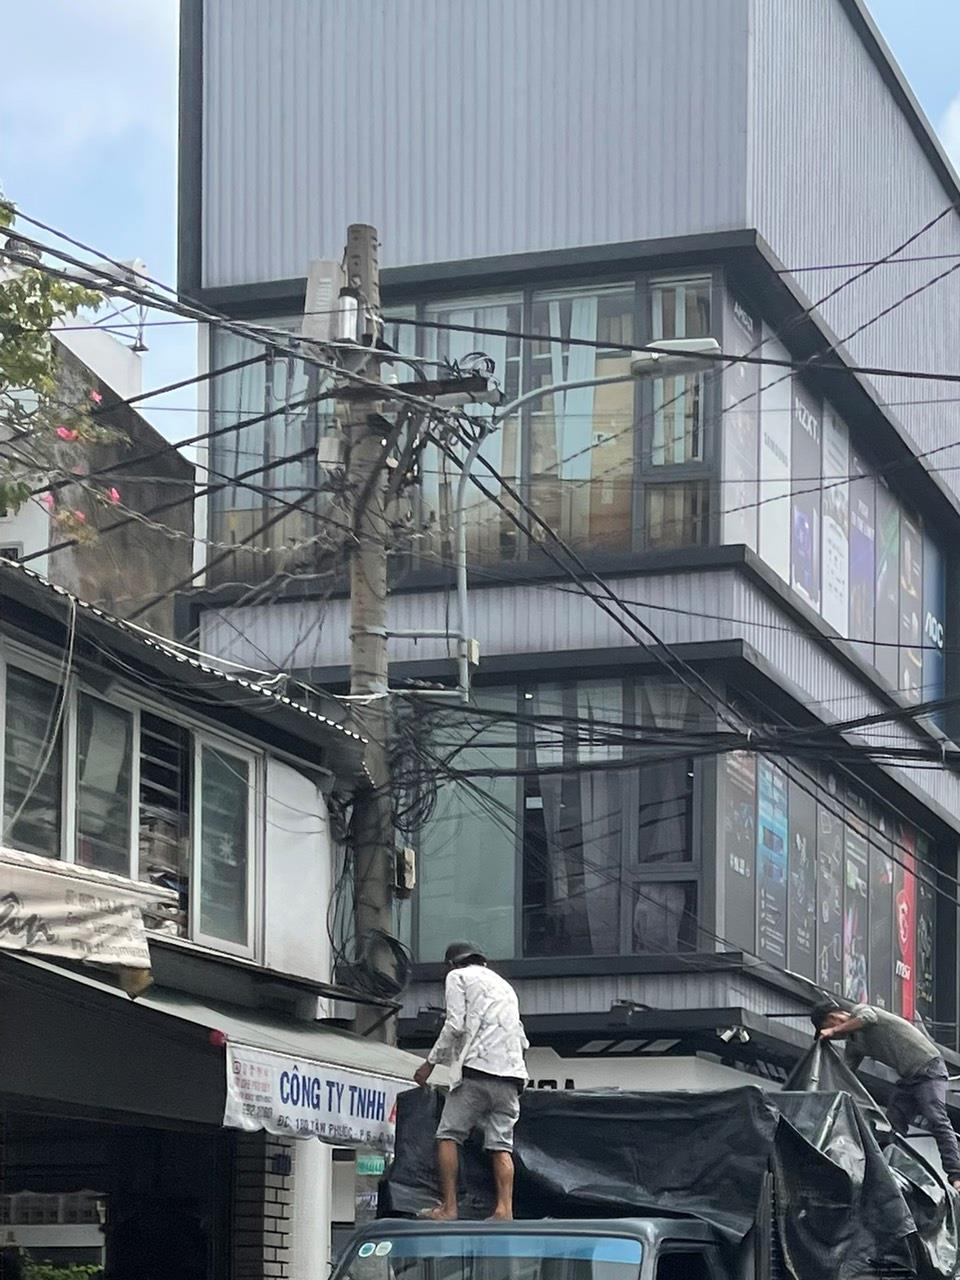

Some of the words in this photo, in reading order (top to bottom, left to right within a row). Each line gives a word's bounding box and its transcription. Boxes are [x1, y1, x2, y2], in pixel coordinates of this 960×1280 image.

[280, 1064, 321, 1111] CÔNG
[326, 1080, 345, 1114] TY
[349, 1085, 386, 1122] TNHH
